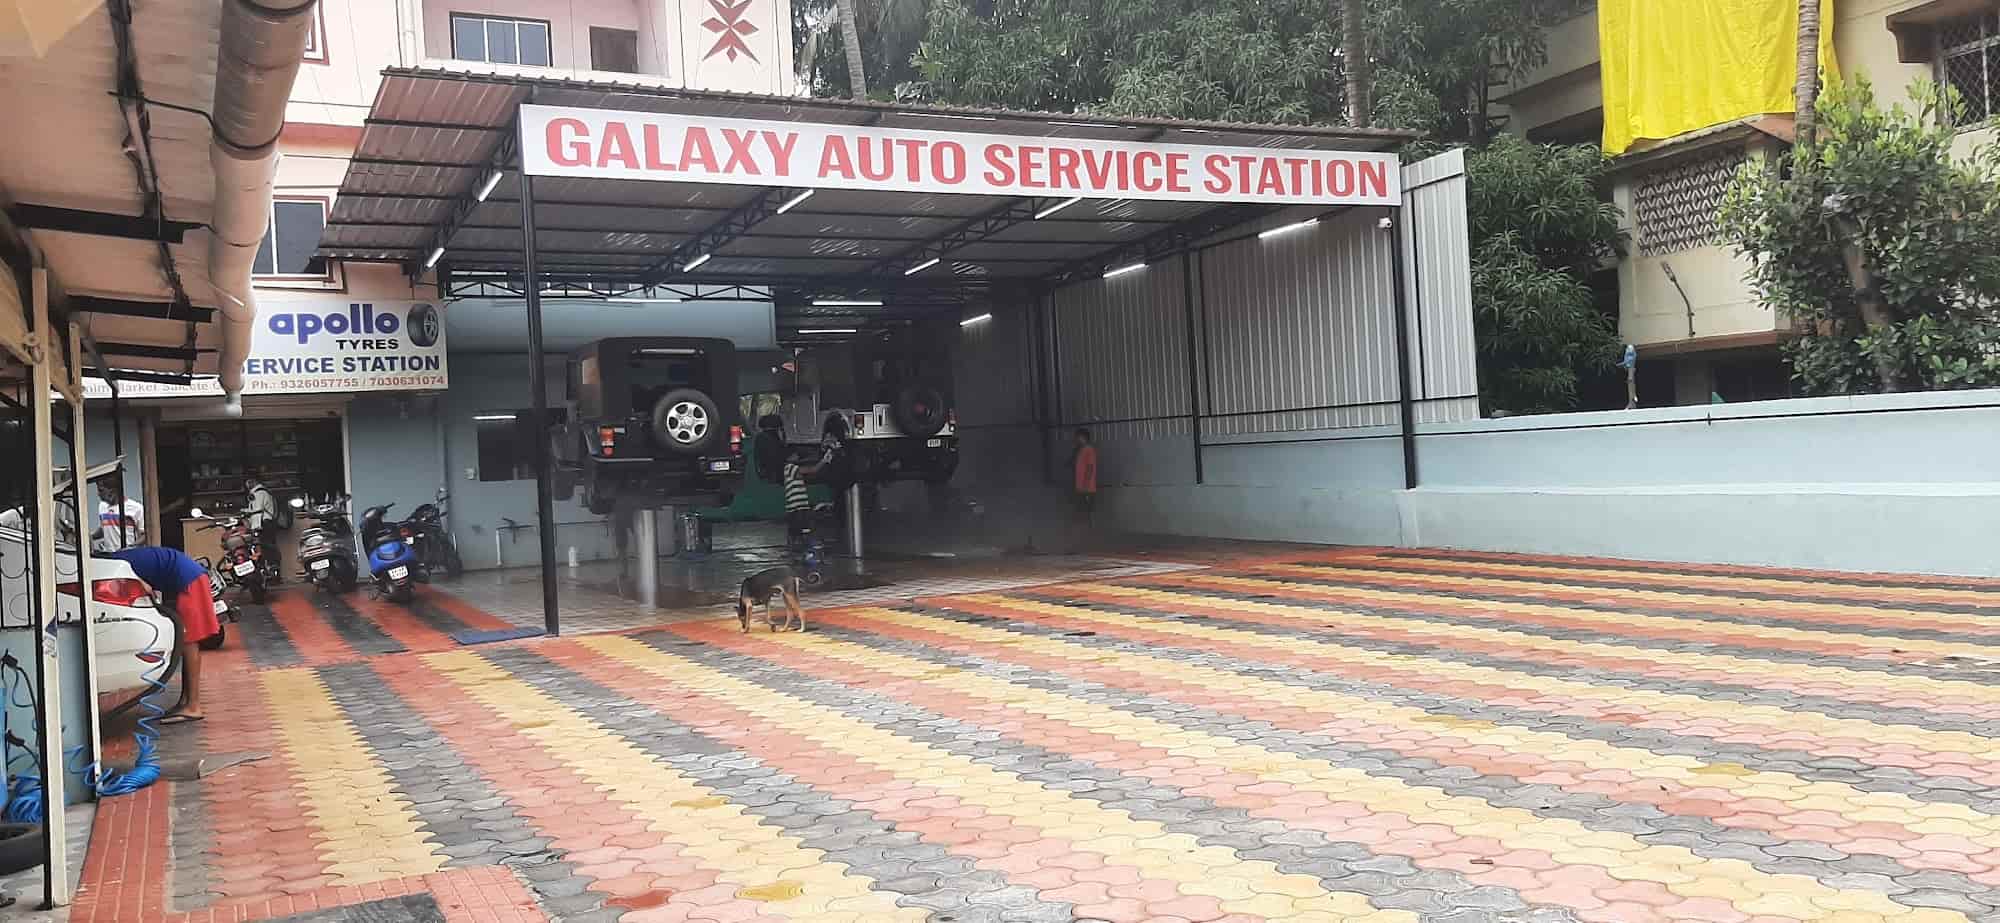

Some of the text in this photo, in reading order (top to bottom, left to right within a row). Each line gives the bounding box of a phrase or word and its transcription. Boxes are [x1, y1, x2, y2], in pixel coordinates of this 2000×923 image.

[545, 117, 1388, 198] GALAXY AUTO SERVICE STATION
[268, 304, 400, 344] apollo
[336, 339, 399, 350] TYRES
[241, 355, 440, 375] ERVICE STATION
